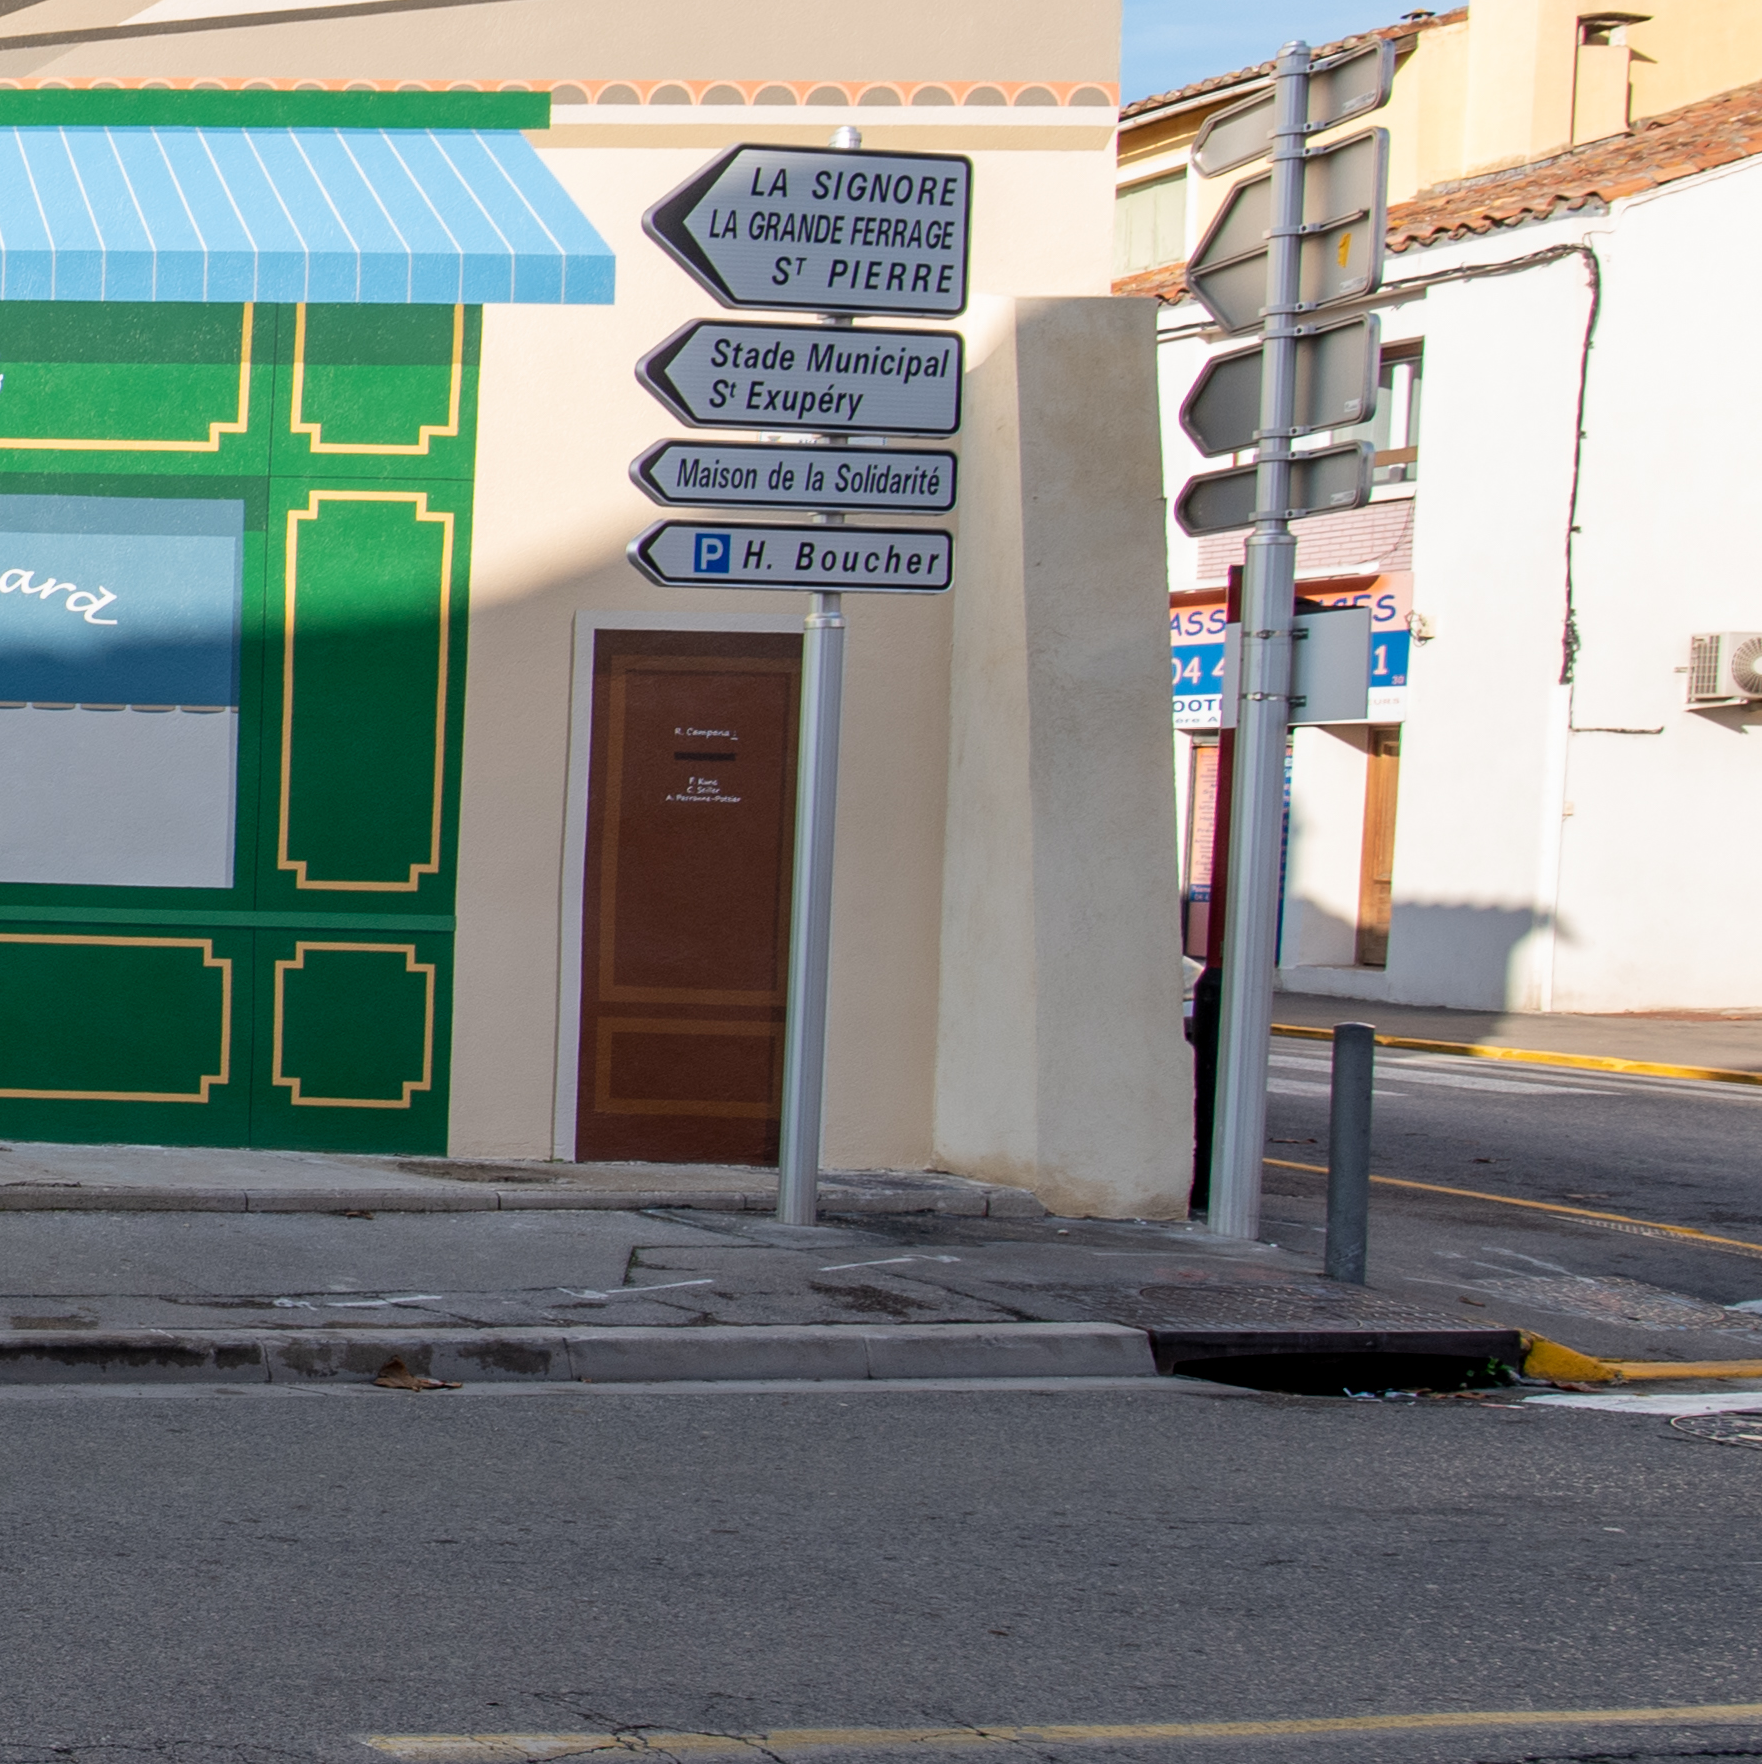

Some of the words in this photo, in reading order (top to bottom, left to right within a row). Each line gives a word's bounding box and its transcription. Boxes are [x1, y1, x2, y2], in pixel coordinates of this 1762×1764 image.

[751, 167, 788, 197] LA
[812, 170, 957, 206] SIGNORE
[709, 209, 737, 239] LA
[748, 211, 845, 244] GRANDE
[850, 217, 955, 250] FERRAGE
[827, 259, 954, 293] PIERRE
[711, 338, 795, 371] Stade
[806, 343, 949, 384] Municipal
[709, 379, 737, 408] St
[746, 381, 864, 421] Exupéry
[677, 458, 758, 489] Maison
[768, 461, 794, 491] de
[805, 462, 824, 491] la
[835, 463, 940, 495] Solidarité
[700, 538, 723, 570] P
[742, 540, 772, 570] H.
[795, 542, 939, 575] Boucher
